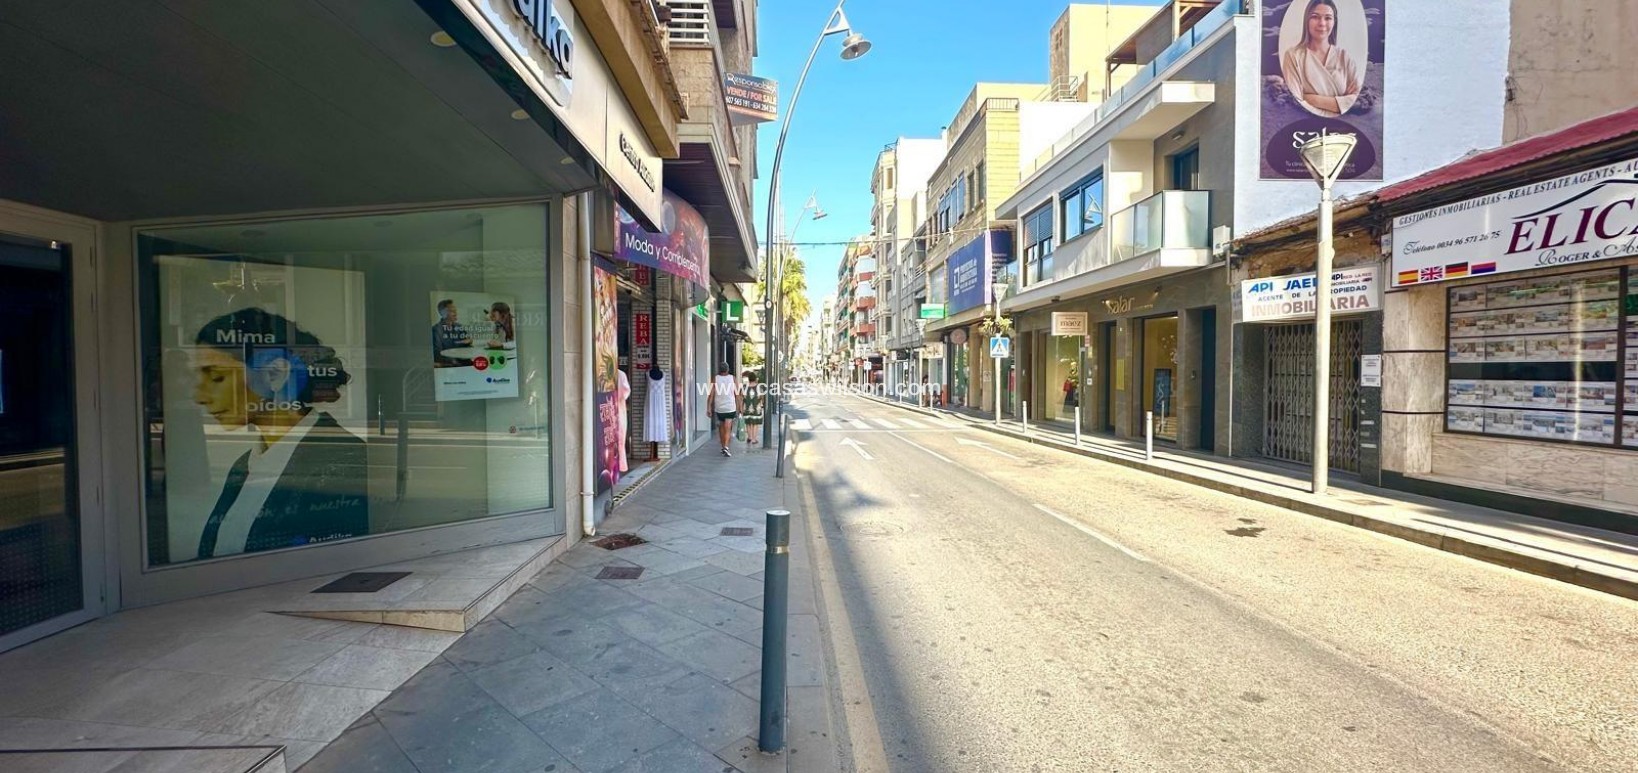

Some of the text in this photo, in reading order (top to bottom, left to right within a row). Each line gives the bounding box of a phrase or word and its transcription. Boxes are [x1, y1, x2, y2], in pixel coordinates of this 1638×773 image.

[1399, 210, 1437, 226] GESTIONES
[1438, 193, 1501, 217] INMOBILIARIAS
[1508, 188, 1532, 201] REAL
[1533, 177, 1571, 195] ESTATE
[1571, 166, 1616, 185] AGENTS
[1504, 197, 1638, 256] ELIC
[625, 232, 654, 256] Moda
[655, 246, 661, 260] y
[1436, 241, 1452, 249] 0034
[1464, 236, 1477, 244] 571
[1491, 230, 1502, 239] 75
[1248, 277, 1317, 294] API JAE
[1331, 284, 1368, 295] OPIEDAD
[1251, 295, 1370, 317] INMOBILRIA
[216, 329, 276, 343] Mima
[307, 365, 338, 377] tus
